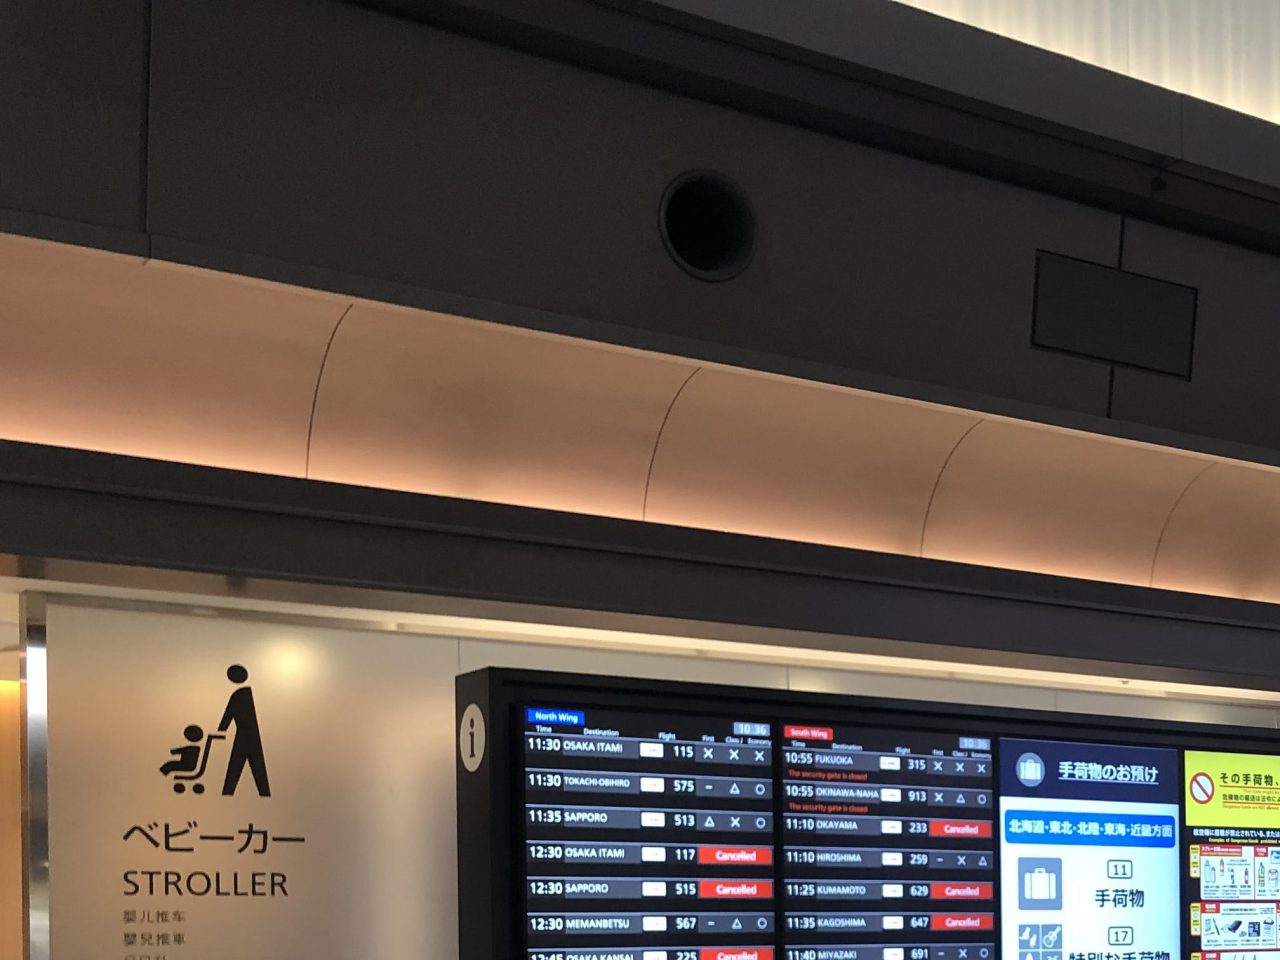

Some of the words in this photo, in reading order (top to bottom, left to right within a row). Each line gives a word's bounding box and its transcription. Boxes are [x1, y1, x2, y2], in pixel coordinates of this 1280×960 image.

[536, 712, 555, 721] North
[559, 713, 578, 723] Wing
[536, 725, 552, 733] Time
[584, 728, 619, 737] Destination
[658, 732, 676, 741] Flight
[791, 728, 809, 737] South
[811, 729, 827, 739] Wing
[528, 738, 560, 751] 11:30
[563, 741, 595, 751] OSAKA
[598, 743, 623, 752] ITAMI
[674, 746, 693, 757] 115
[832, 743, 863, 751] Destination
[896, 747, 910, 755] Flight
[785, 752, 813, 764] 10:55
[816, 756, 853, 765] FUKUOKA
[908, 759, 926, 770] 315
[1059, 762, 1158, 782] 手荷物のお預け
[529, 774, 561, 787] 11:30
[564, 777, 629, 788] TOKACHI-OBIHIRO
[674, 780, 694, 791] 575
[786, 786, 813, 796] 10:55
[817, 789, 879, 799] OKINAWA-NAHA
[908, 792, 926, 802] 913
[529, 810, 561, 823] 11:35
[564, 813, 607, 823] SAPPORO
[674, 815, 694, 826] 513
[786, 819, 814, 830] 11:10
[817, 821, 858, 830] OKAYAMA
[909, 823, 927, 833] 233
[944, 825, 979, 834] Cancelled
[123, 821, 305, 854] ベビーカー
[530, 846, 562, 858] 12:30
[565, 848, 597, 858] OSAKA
[599, 849, 624, 858] ITAMI
[676, 849, 695, 861] 117
[716, 851, 756, 861] Cancelled
[786, 852, 814, 863] 11:10
[817, 854, 862, 862] HIROSHIMA
[910, 854, 928, 865] 259
[1112, 863, 1128, 876] 11
[123, 871, 288, 897] STROLLER
[530, 882, 563, 894] 12:30
[566, 884, 608, 893] SAPPORO
[676, 884, 696, 895] 515
[716, 885, 756, 895] Cancelled
[787, 885, 815, 896] 11:25
[818, 886, 866, 895] KUMAMOTO
[910, 886, 928, 896] 629
[945, 887, 979, 896] Cancelled
[1095, 889, 1144, 908] 手荷物
[531, 918, 563, 930] 12:30
[566, 919, 629, 928] MEMANBETSU
[676, 918, 696, 929] 567
[787, 918, 815, 929] 11:35
[818, 918, 866, 927] KAGOSHIMA
[911, 917, 928, 928] 647
[946, 919, 979, 927] Cancelled
[1114, 930, 1128, 942] 17
[788, 951, 816, 960] 11:40
[818, 950, 857, 959] MIYAZAKI
[911, 949, 928, 959] 691
